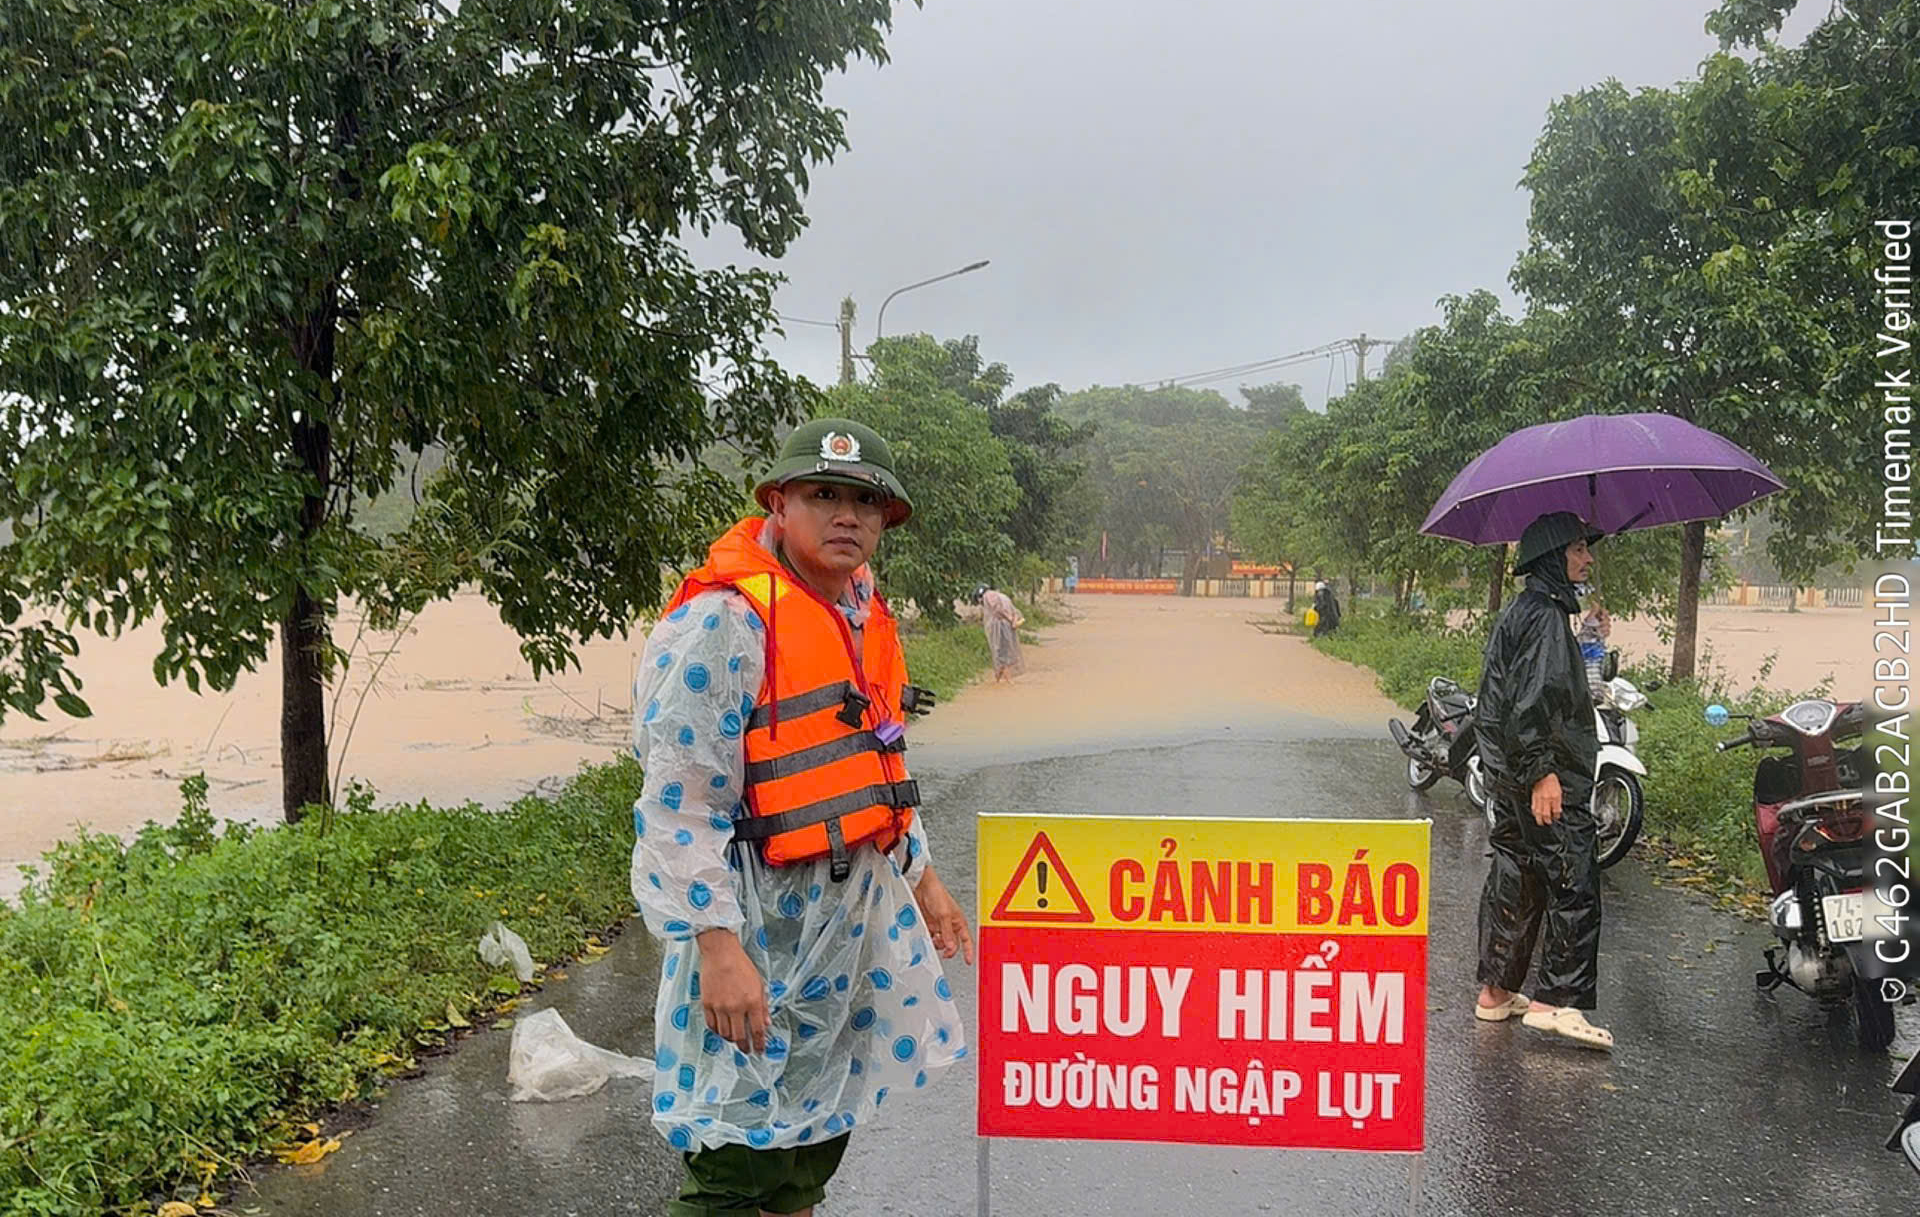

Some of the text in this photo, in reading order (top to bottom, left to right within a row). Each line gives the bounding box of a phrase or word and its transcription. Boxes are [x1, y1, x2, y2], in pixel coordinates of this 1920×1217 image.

[1108, 838, 1420, 927] CẢNH BÁO
[1001, 939, 1405, 1045] NGUY HIỂM
[1003, 1052, 1401, 1130] ĐƯỜNG NGẬP LỤT
